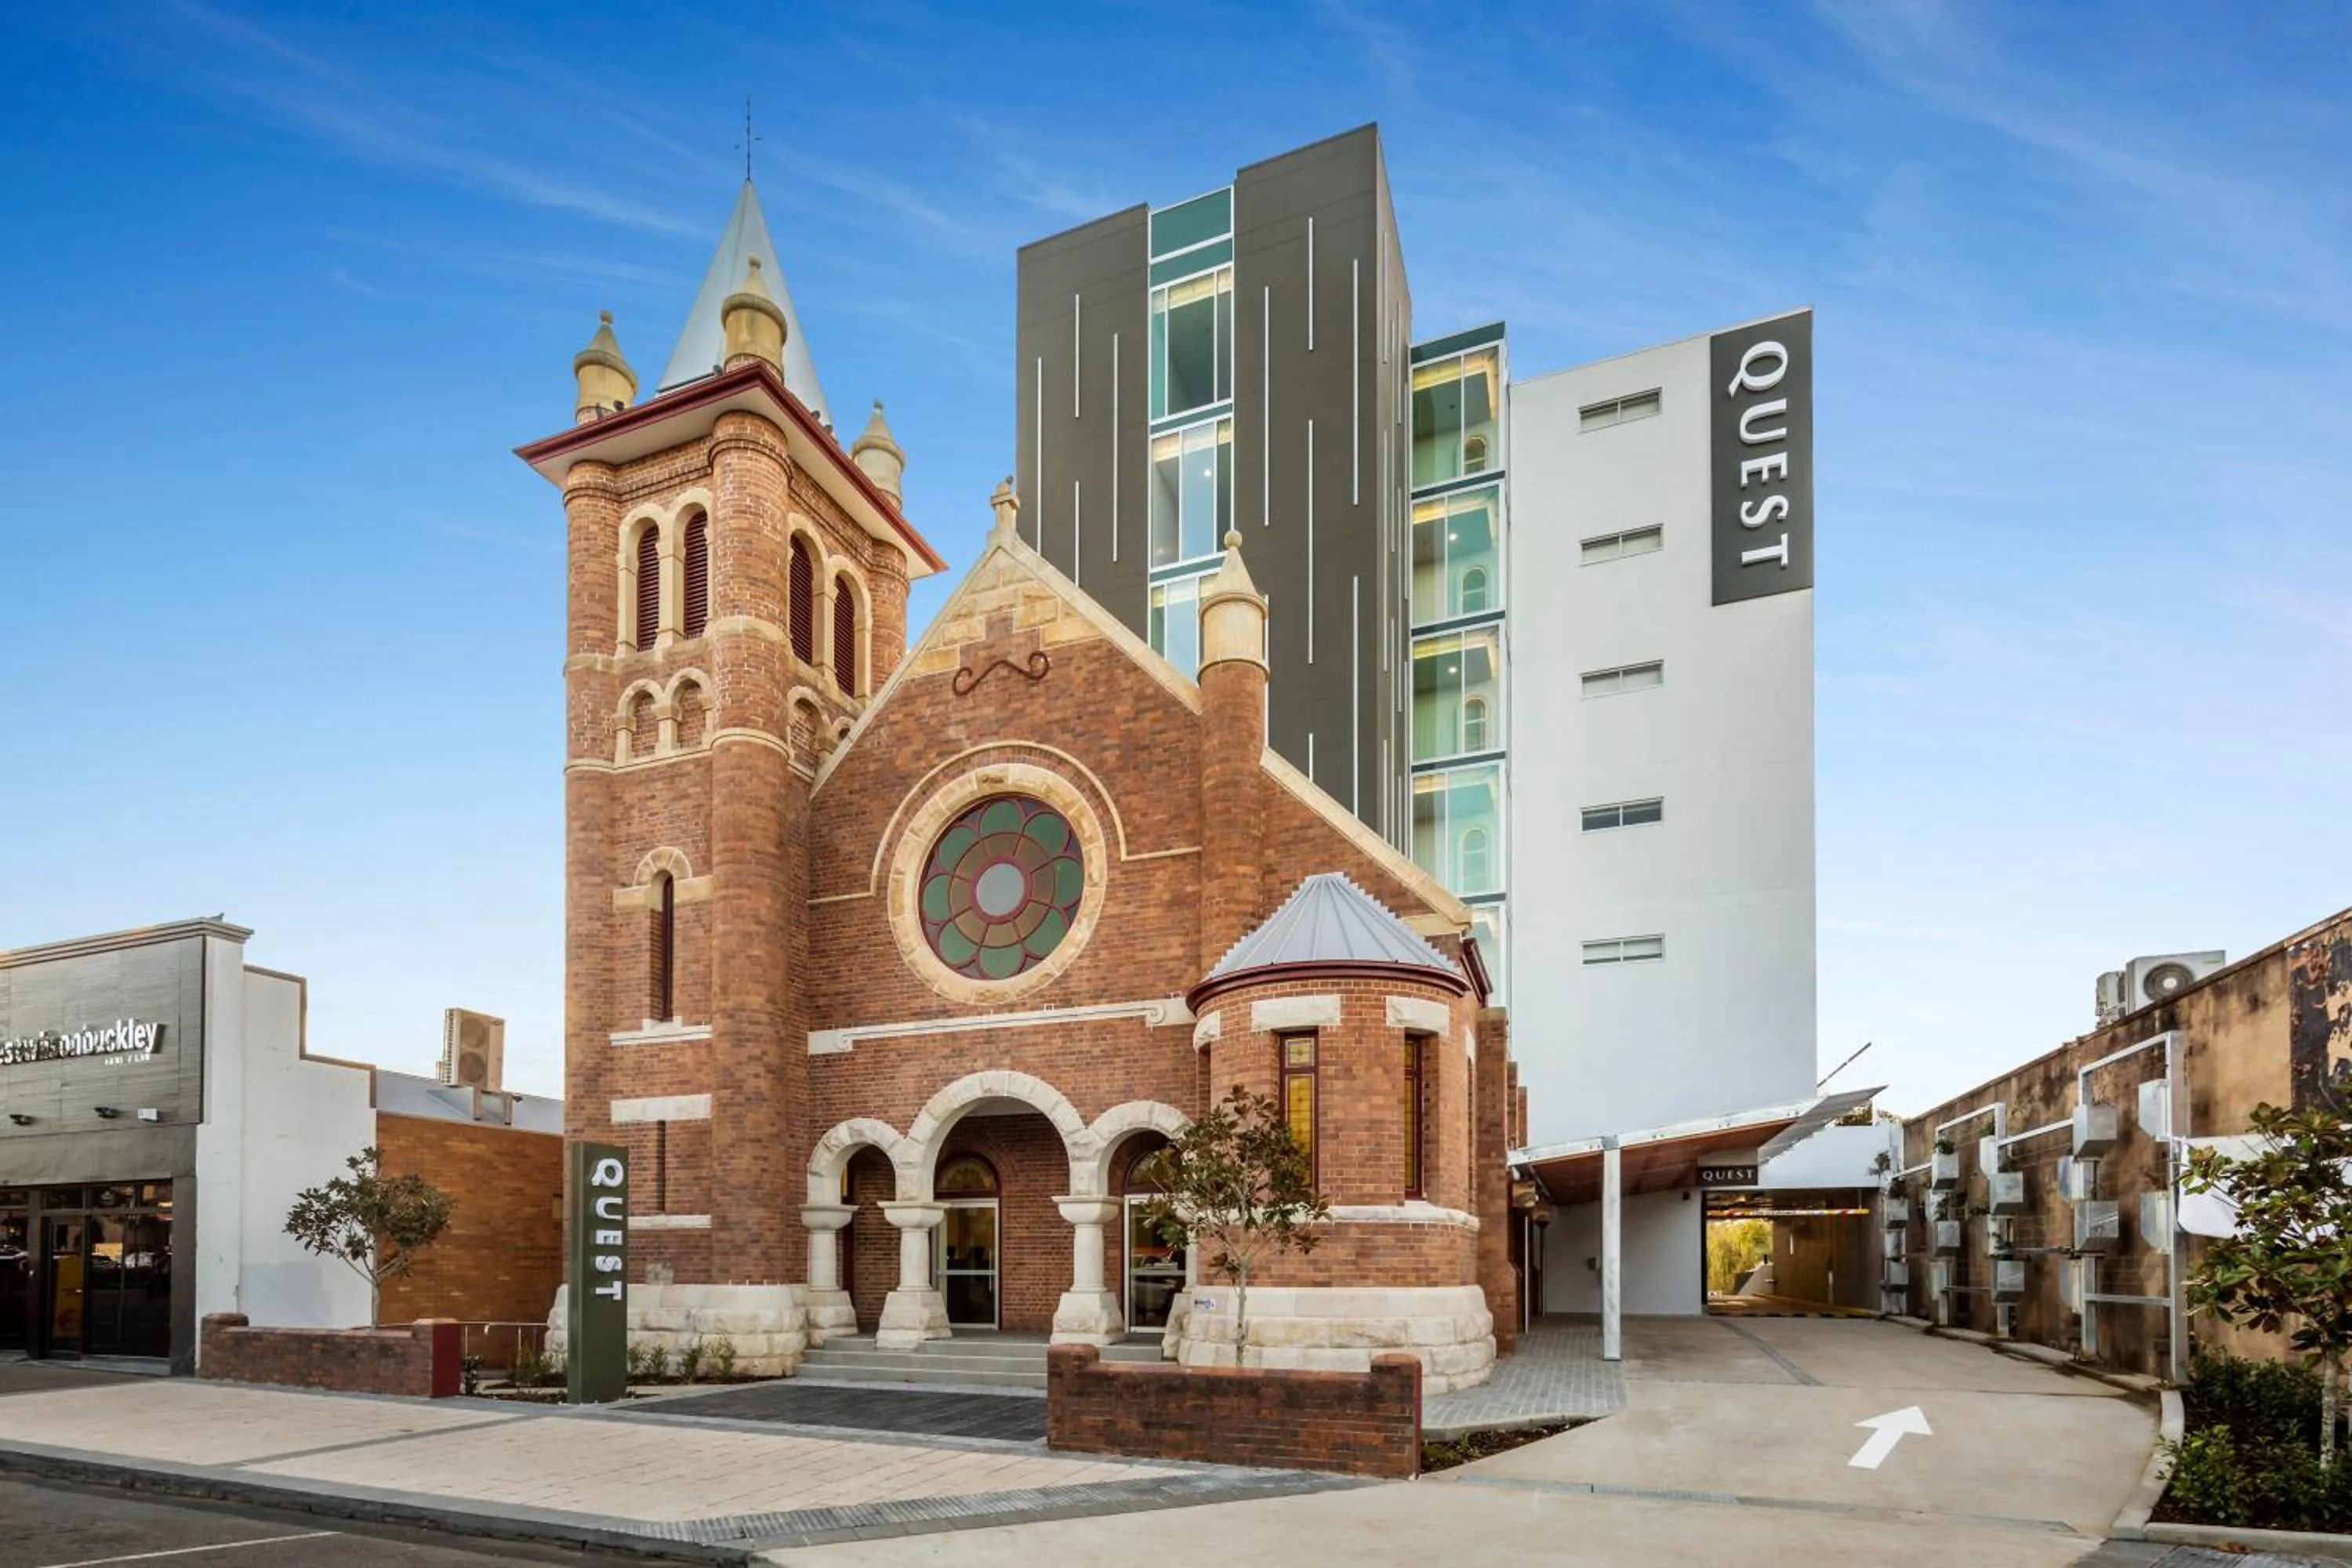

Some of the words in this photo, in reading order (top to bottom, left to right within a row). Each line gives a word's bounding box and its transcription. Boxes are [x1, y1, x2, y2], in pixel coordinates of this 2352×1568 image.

[1728, 340, 1789, 568] QUEST
[591, 1158, 624, 1301] QUEST
[1702, 1169, 1754, 1181] QUEST
